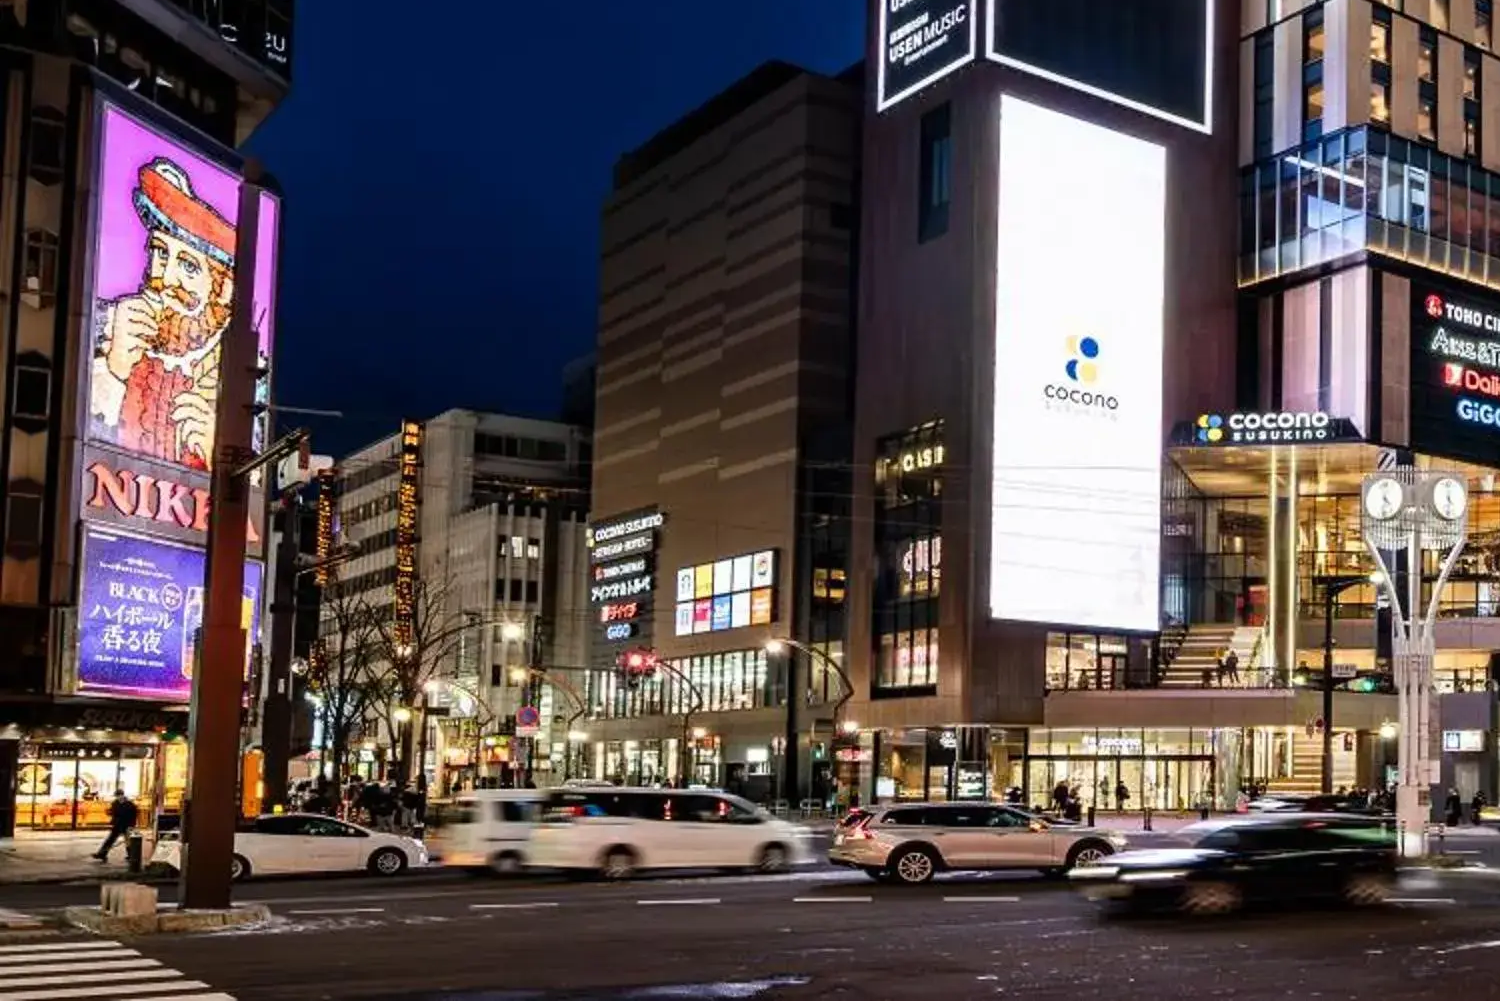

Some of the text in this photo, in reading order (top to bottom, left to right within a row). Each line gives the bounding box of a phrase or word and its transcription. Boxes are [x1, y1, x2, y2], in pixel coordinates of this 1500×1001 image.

[889, 30, 923, 63] USEN
[923, 3, 966, 42] MUSIC
[1445, 302, 1483, 329] TOHO
[87, 462, 260, 543] NIK
[109, 581, 161, 605] BLACK
[90, 603, 175, 629] ハイボール
[102, 623, 163, 655] 香る夜
